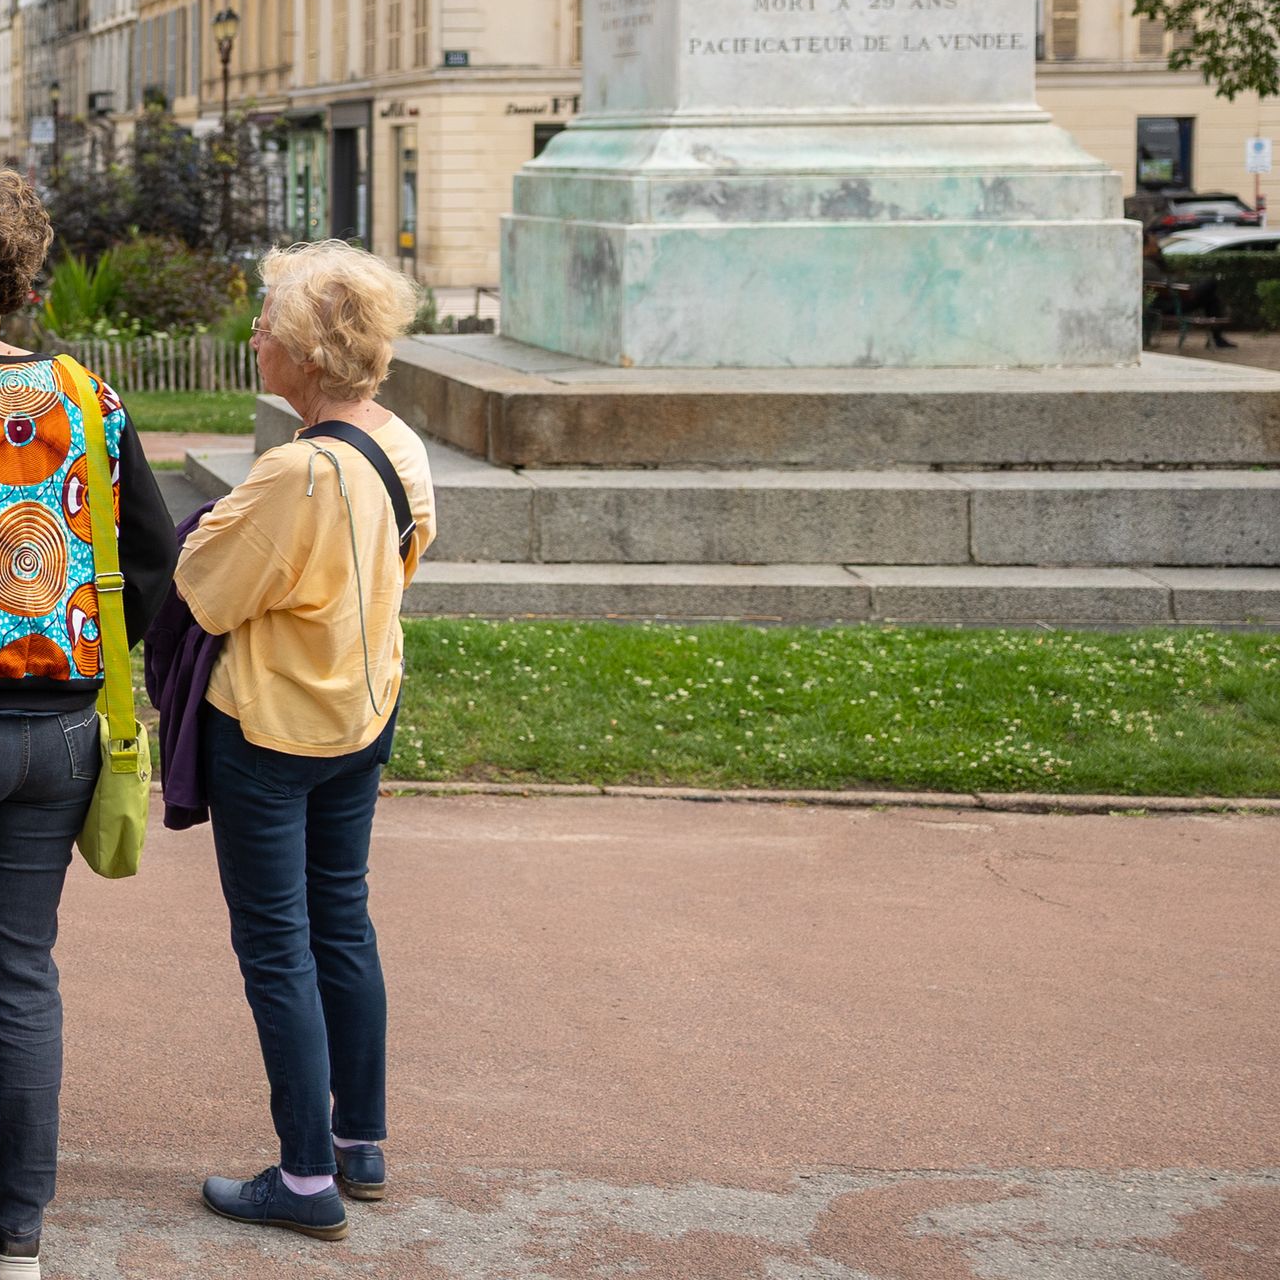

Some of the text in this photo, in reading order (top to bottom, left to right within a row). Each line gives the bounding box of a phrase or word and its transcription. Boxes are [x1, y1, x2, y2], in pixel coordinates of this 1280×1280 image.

[688, 35, 854, 55] PACIFICATEUR
[863, 34, 891, 52] DE
[903, 34, 932, 52] LA
